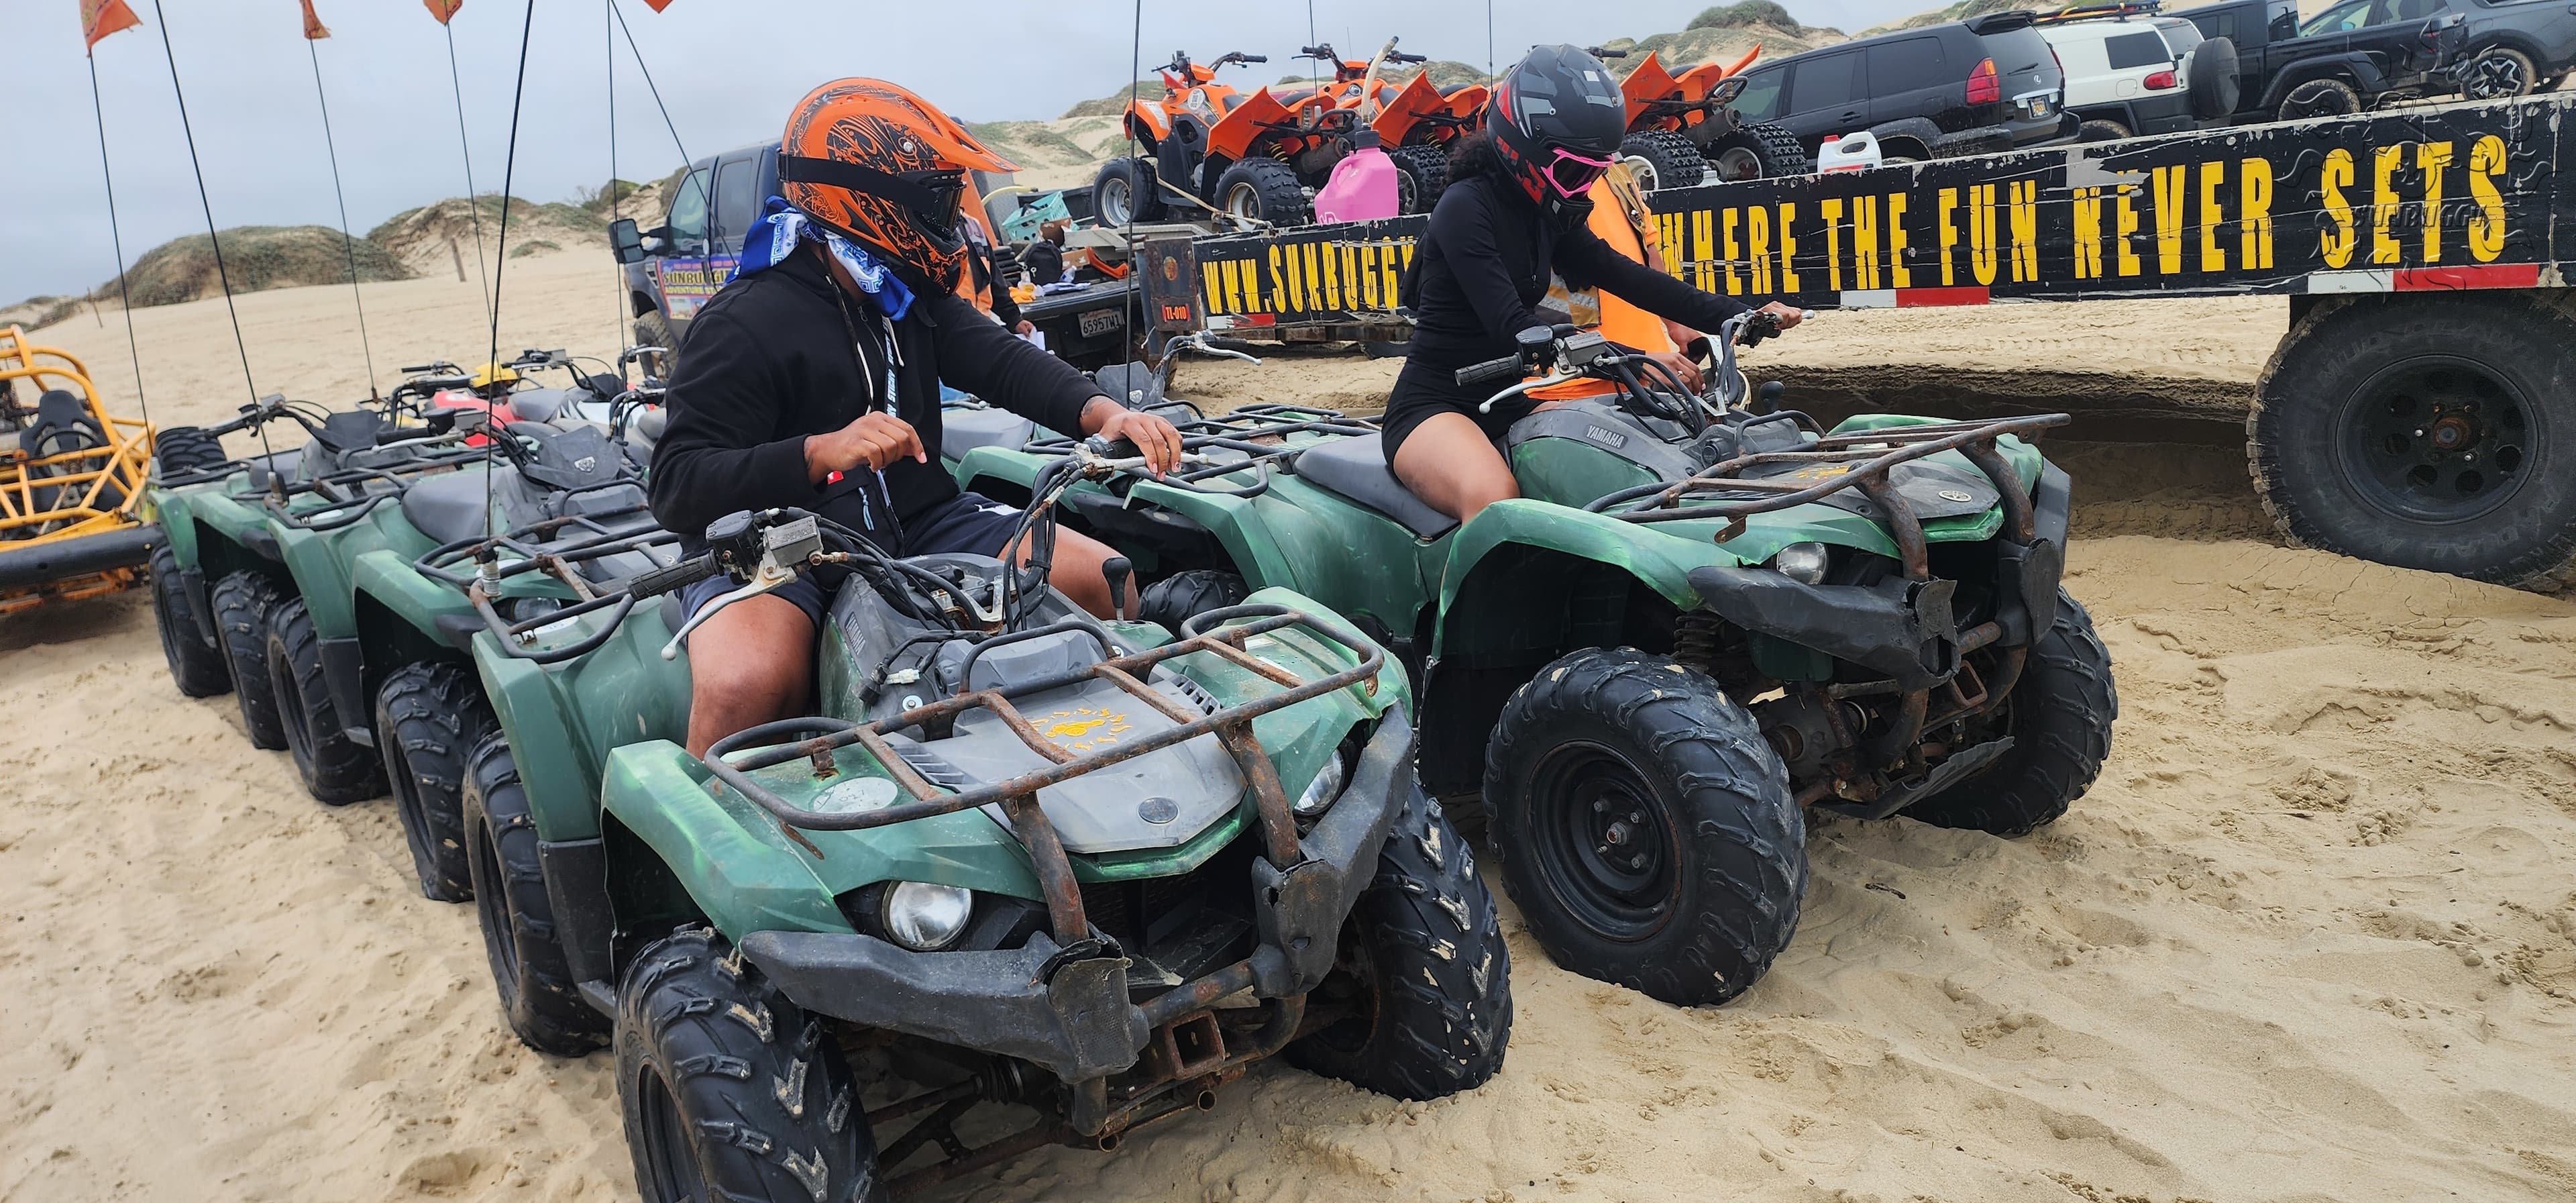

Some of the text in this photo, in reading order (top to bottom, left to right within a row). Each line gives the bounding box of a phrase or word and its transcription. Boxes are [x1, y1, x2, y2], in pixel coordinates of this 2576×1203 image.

[1652, 203, 1800, 296] WHERE
[1821, 192, 1911, 291] THE
[1938, 179, 2038, 286] FUN
[2073, 157, 2273, 279] NEVER
[2320, 134, 2507, 268] SETS
[1587, 425, 1625, 448] YAMAHA
[846, 613, 865, 656] YAMAHA
